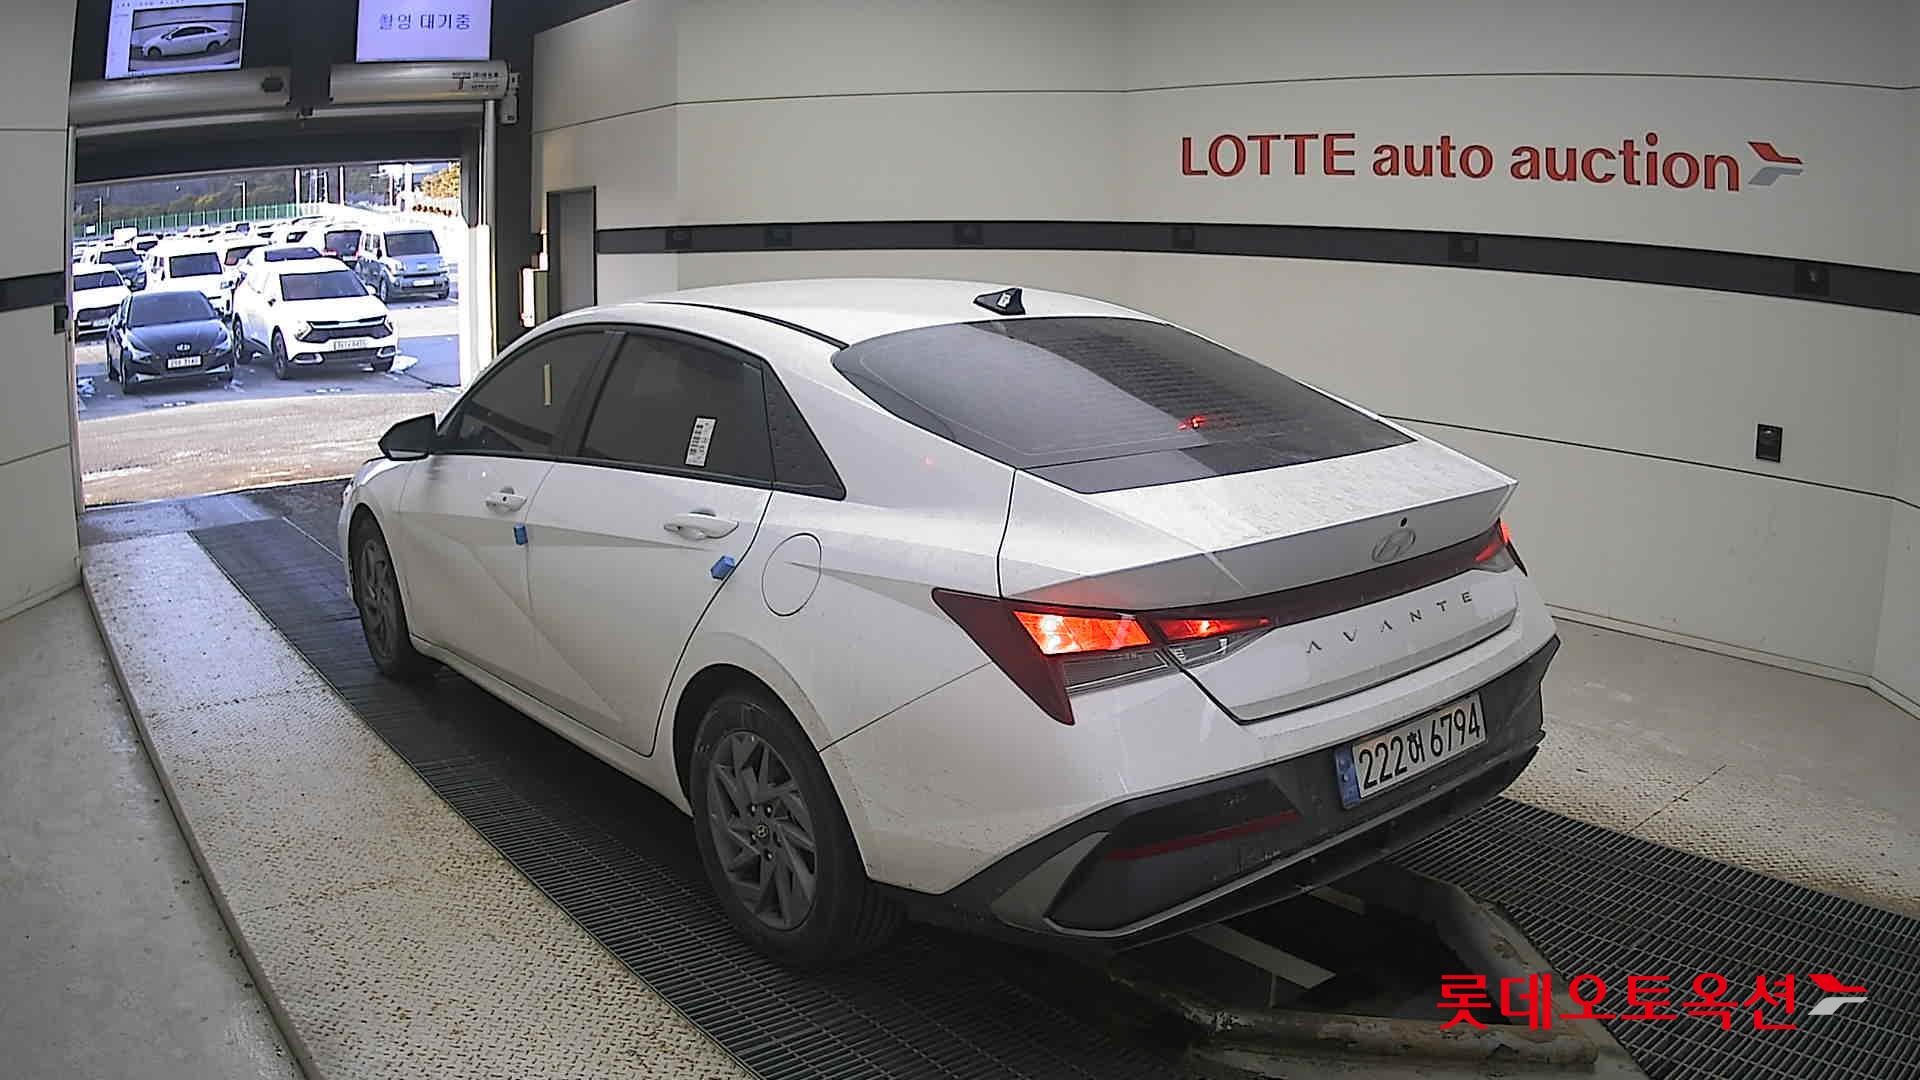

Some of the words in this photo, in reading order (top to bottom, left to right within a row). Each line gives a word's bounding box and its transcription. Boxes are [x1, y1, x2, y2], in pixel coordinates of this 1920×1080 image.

[420, 13, 472, 30] 대기중
[1181, 133, 1357, 177] LOTTE
[1371, 135, 1495, 179] auto
[1509, 132, 1741, 191] auction
[1305, 591, 1473, 654] AVANTE
[1358, 728, 1426, 790] 222허
[1430, 703, 1480, 757] 6794
